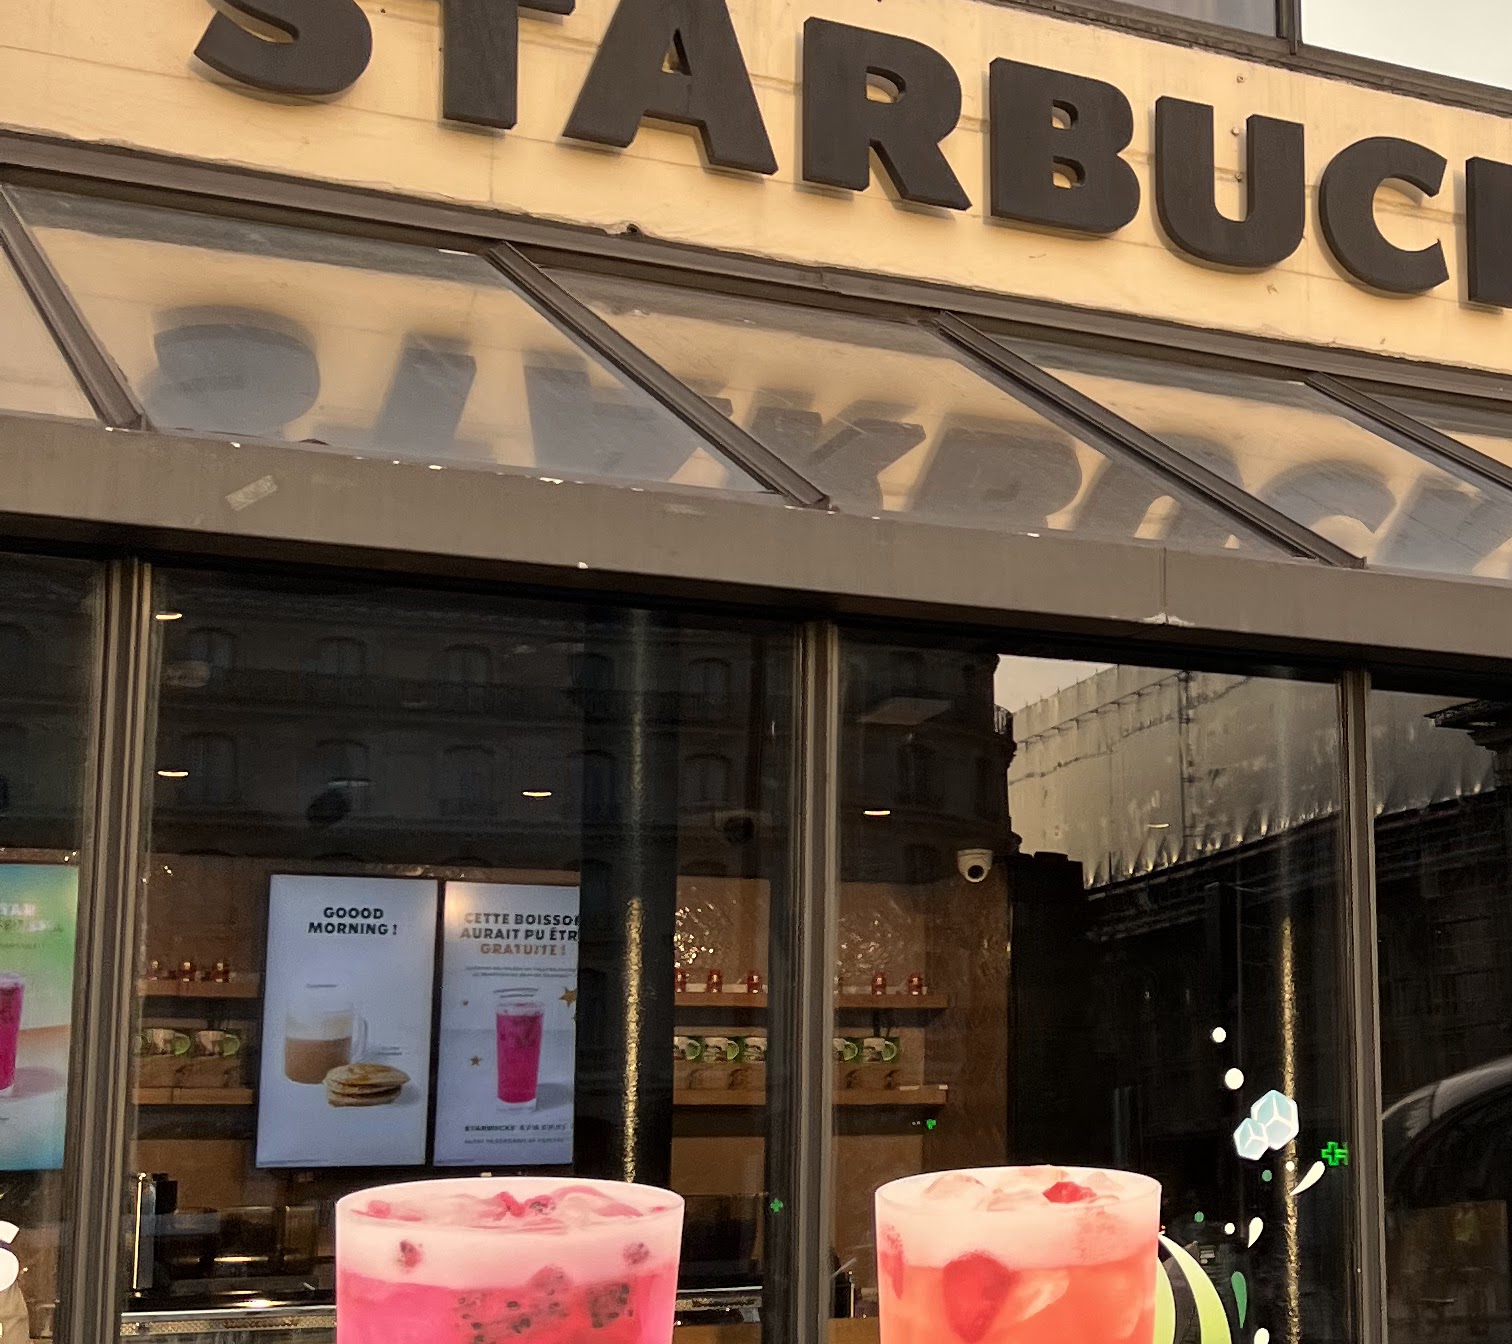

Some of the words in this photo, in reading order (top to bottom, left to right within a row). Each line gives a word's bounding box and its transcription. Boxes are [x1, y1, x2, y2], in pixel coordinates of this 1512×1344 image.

[323, 906, 384, 919] GOOOD
[464, 912, 510, 924] CETTE
[307, 921, 388, 935] MORNING
[460, 927, 520, 940] AURAIT
[524, 929, 545, 941] PU
[480, 943, 556, 955] GRATUITE
